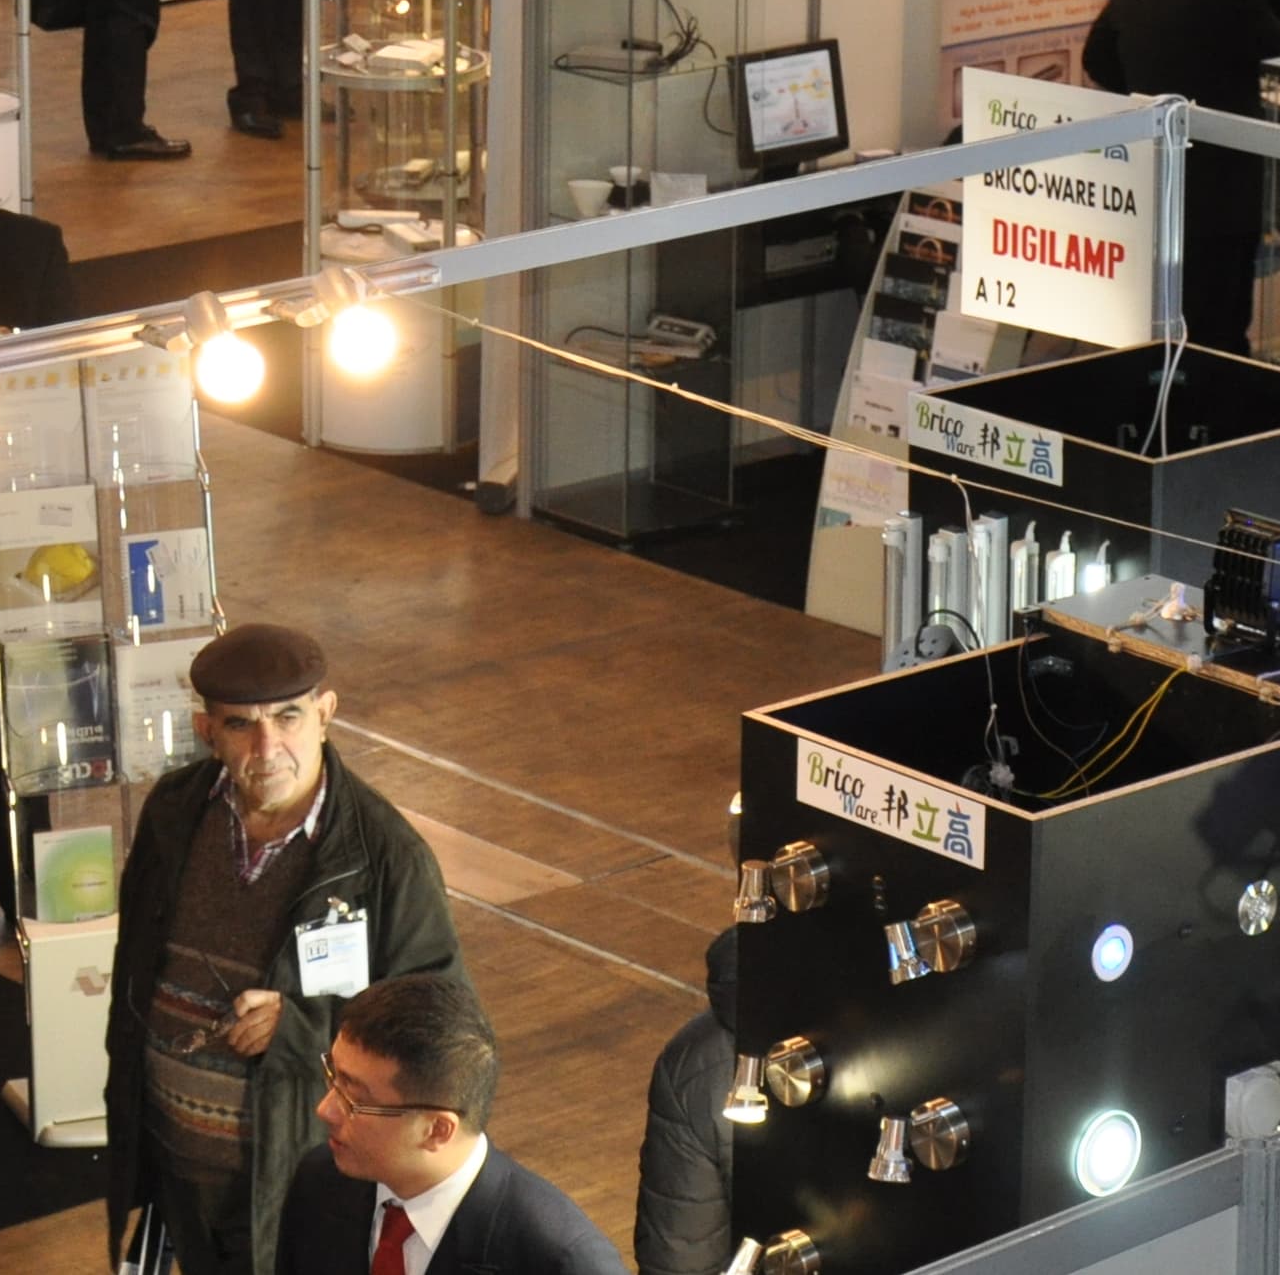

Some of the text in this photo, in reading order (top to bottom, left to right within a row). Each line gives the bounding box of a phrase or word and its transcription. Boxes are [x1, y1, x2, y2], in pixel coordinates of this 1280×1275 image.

[989, 99, 1037, 133] Brico
[984, 166, 1137, 216] BRICO-WARE LDA
[993, 219, 1124, 280] DIGILAMP
[976, 277, 1016, 308] A 12
[916, 399, 964, 436] Brico
[807, 751, 863, 800] Brico
